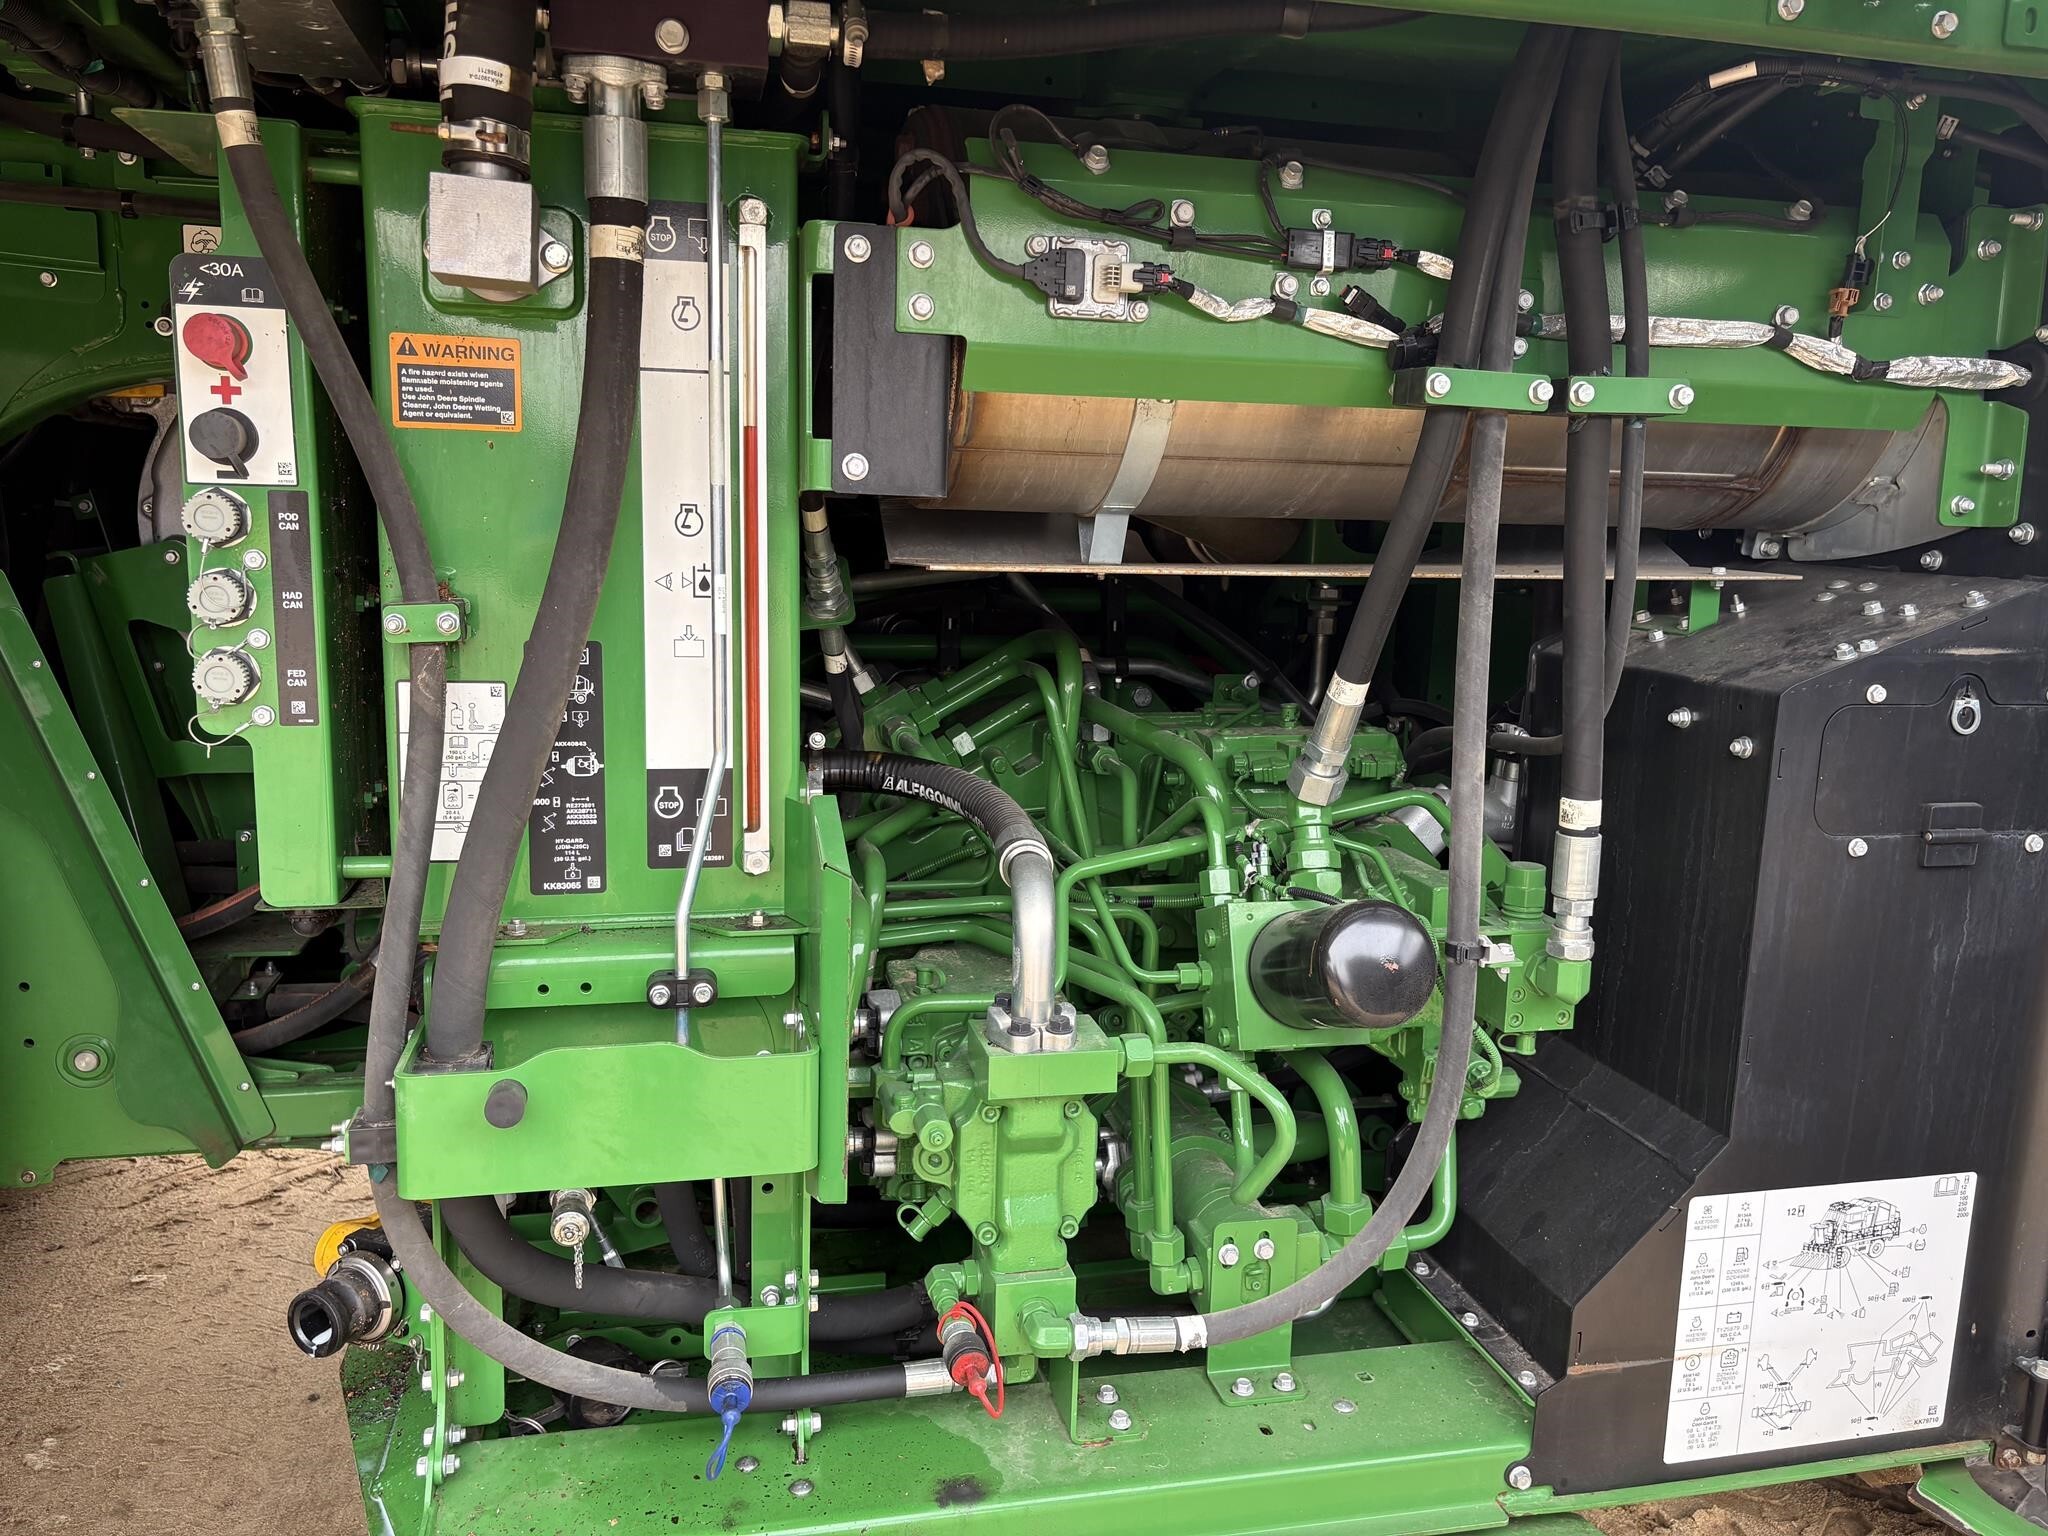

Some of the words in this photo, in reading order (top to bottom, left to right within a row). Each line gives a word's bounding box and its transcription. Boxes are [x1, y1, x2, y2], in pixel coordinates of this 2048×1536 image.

[650, 233, 672, 242] STOP
[199, 262, 244, 277] <30A
[422, 343, 515, 362] WARNING
[422, 368, 446, 376] hazard
[447, 369, 468, 378] exists
[469, 371, 488, 379] when
[401, 376, 438, 385] flammable
[440, 378, 478, 388] moistening
[480, 380, 503, 389] agents
[415, 385, 434, 393] used.
[459, 396, 485, 404] Spindle
[402, 401, 432, 410] Cleaner,
[474, 404, 501, 413] Wetting
[402, 410, 424, 418] Agent
[434, 411, 473, 419] equivalent.
[278, 512, 299, 521] POD
[278, 522, 300, 531] CAN
[282, 591, 303, 600] HAD
[282, 600, 303, 609] CAN
[287, 669, 306, 678] FED
[286, 678, 307, 687] CAN
[658, 801, 680, 809] STOP
[543, 881, 582, 890] KK83065
[1787, 1208, 1797, 1216] 12
